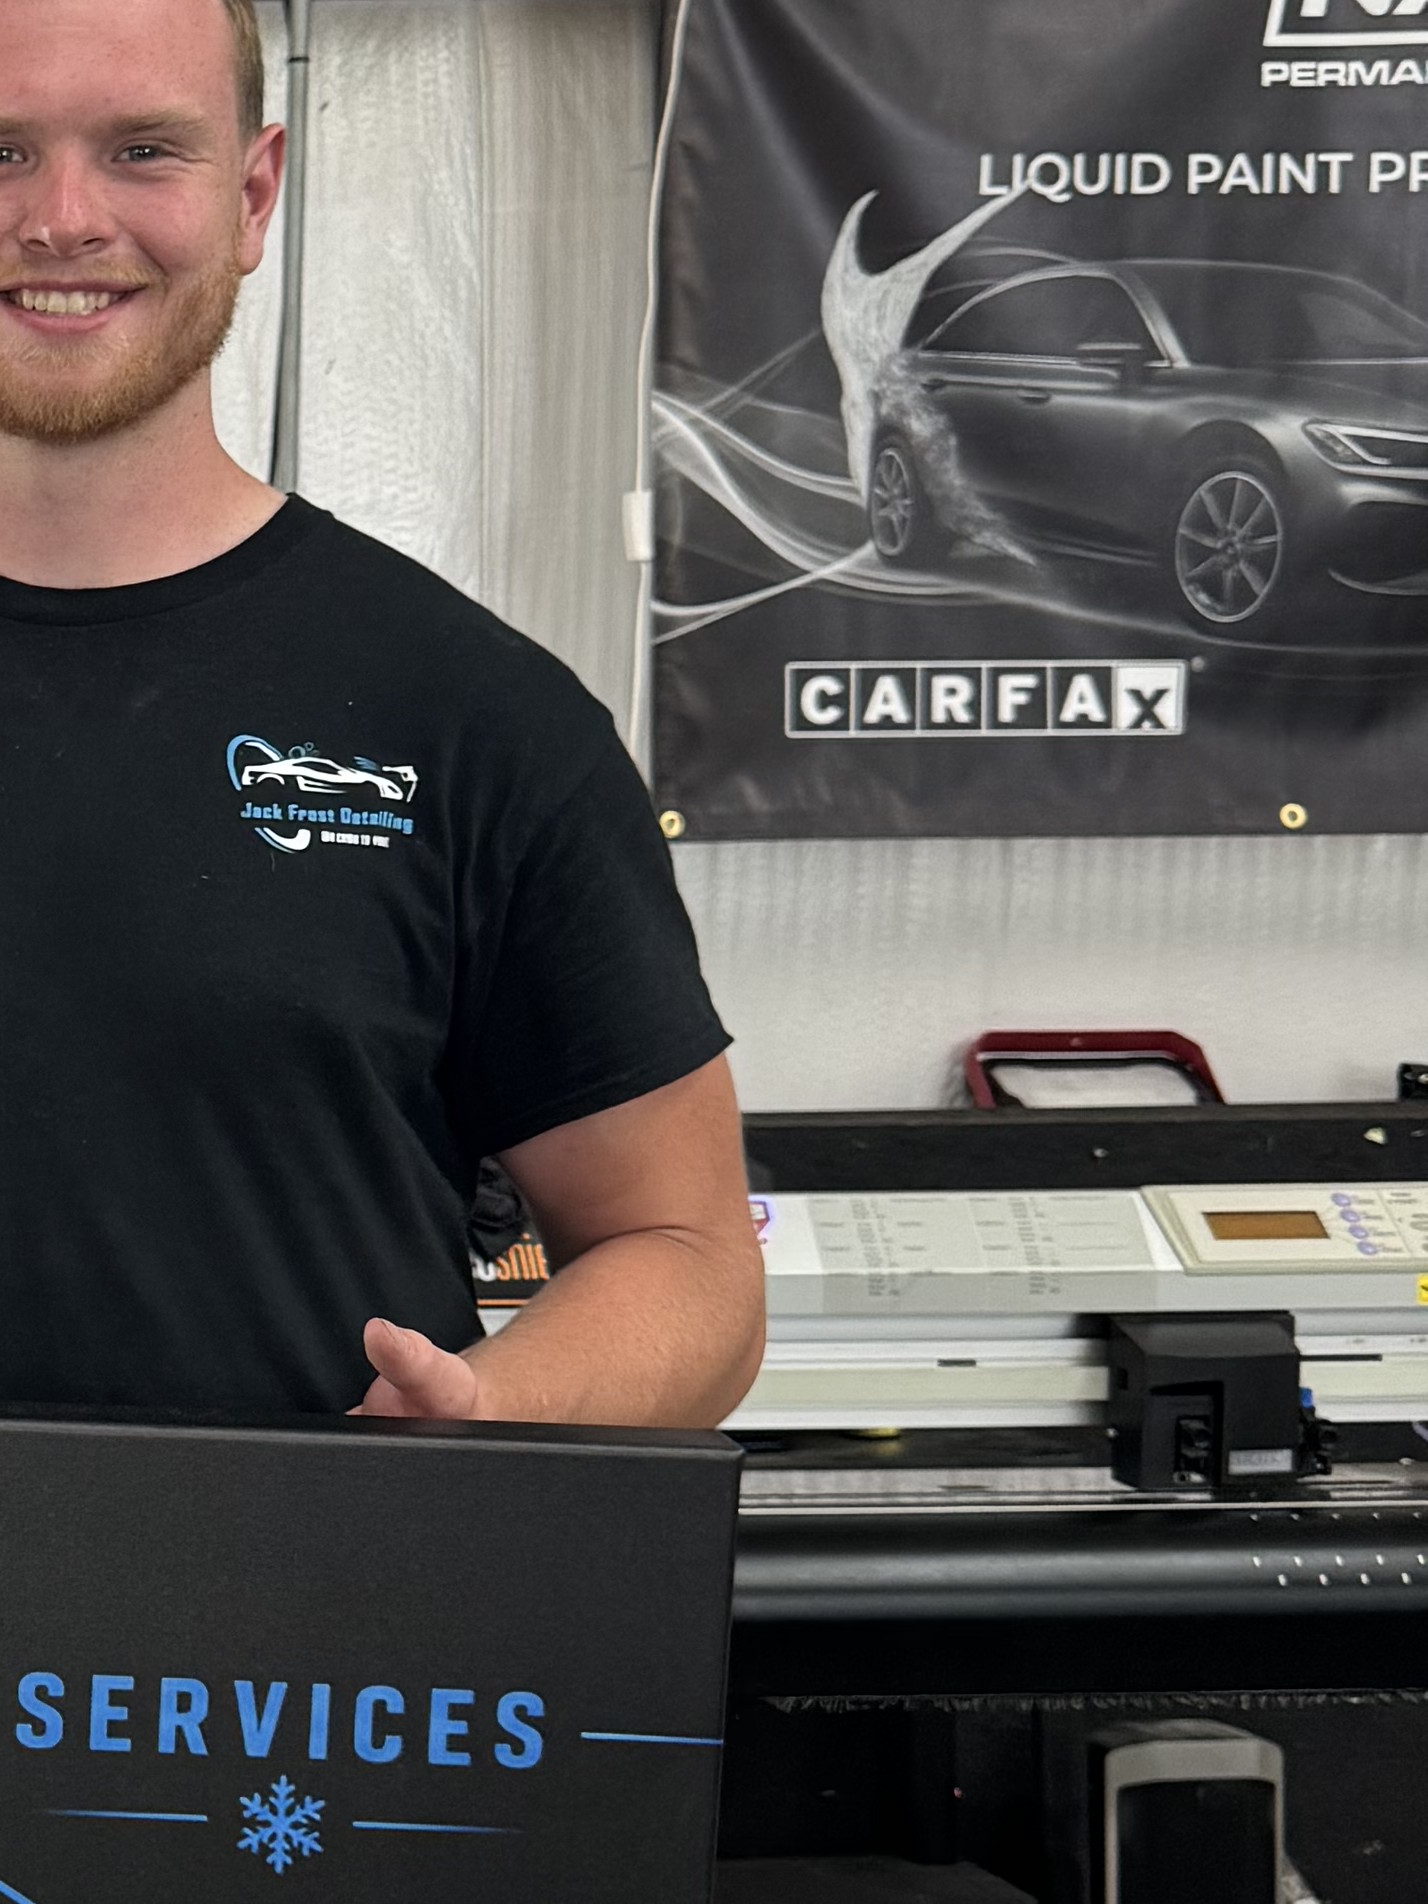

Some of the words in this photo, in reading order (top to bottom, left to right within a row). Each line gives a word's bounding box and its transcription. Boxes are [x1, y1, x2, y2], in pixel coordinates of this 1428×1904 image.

[1260, 59, 1428, 88] PERMA
[978, 152, 1171, 202] LIQUID
[1187, 152, 1354, 195] PAINT
[799, 672, 1176, 731] CARFAX
[240, 802, 283, 821] Jack
[288, 803, 335, 824] Frost
[340, 807, 414, 835] Detailing
[14, 1671, 547, 1770] SERVICES
